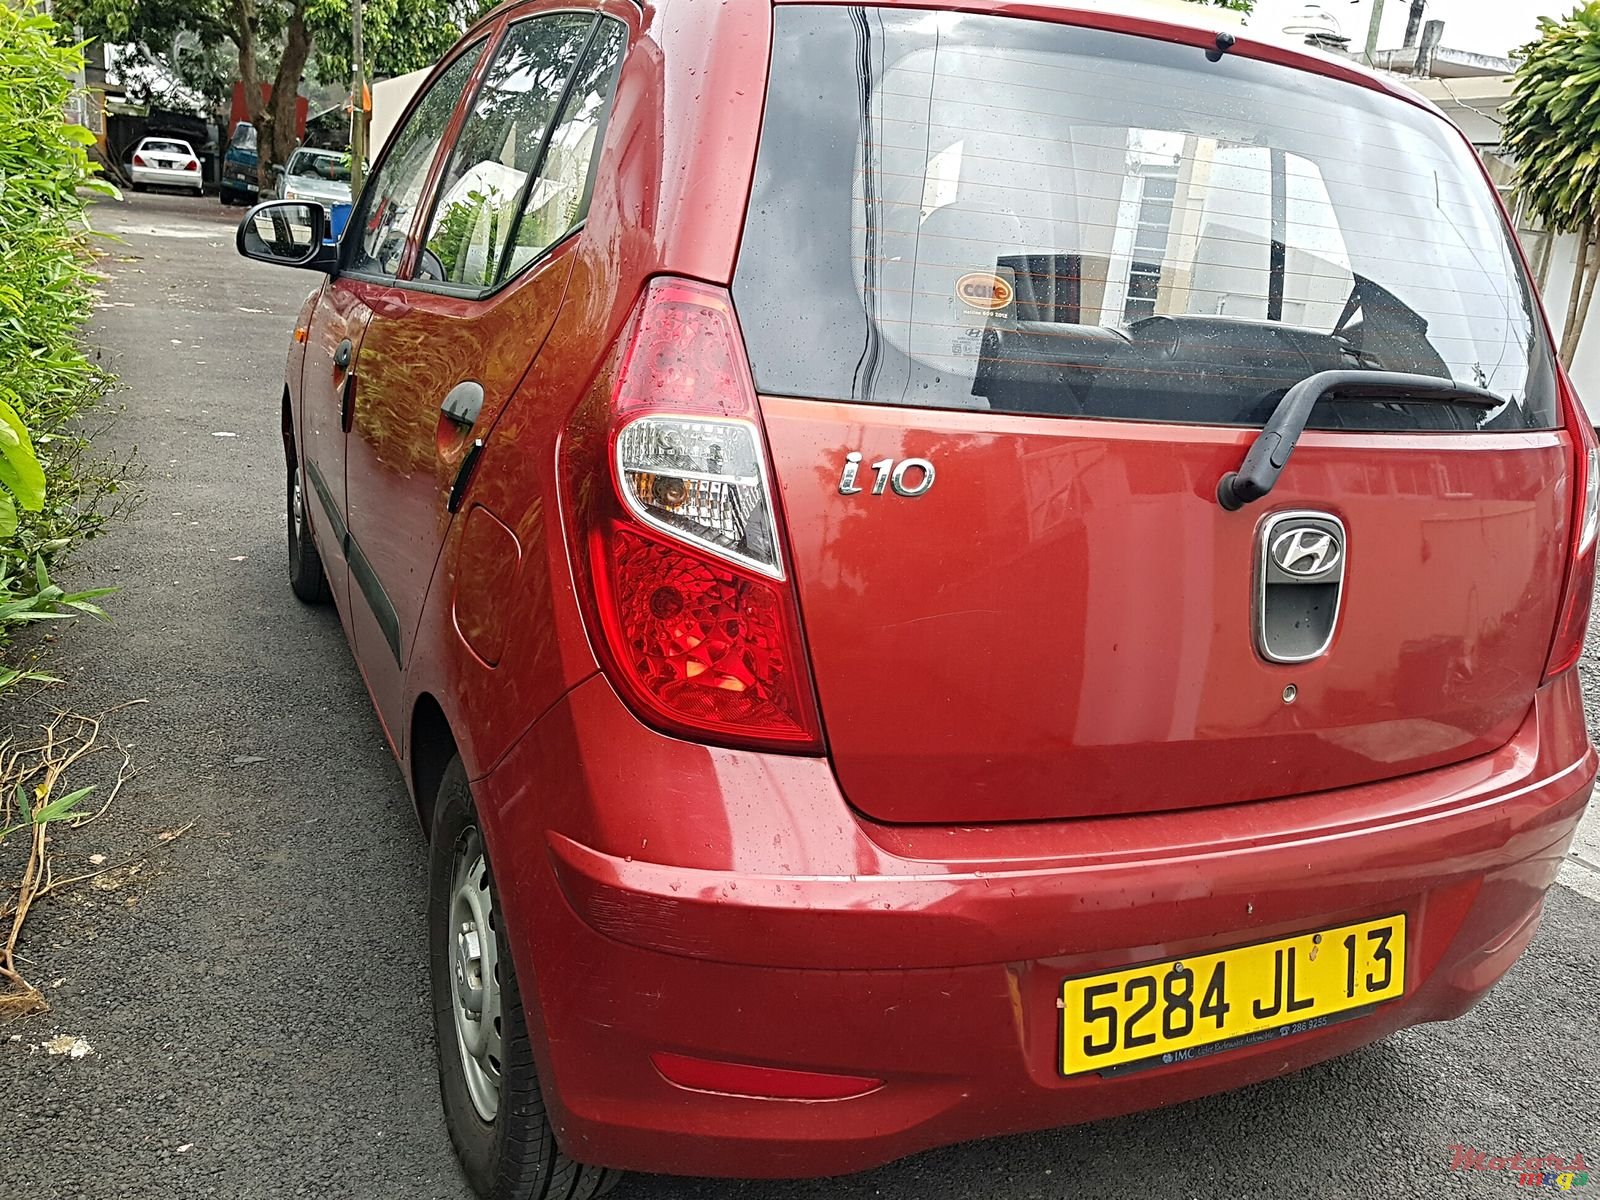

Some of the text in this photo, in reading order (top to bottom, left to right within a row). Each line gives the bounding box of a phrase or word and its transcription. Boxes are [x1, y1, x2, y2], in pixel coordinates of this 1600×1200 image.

[838, 451, 936, 497] i10
[1083, 926, 1393, 1057] 5284 JL 13
[1174, 1049, 1195, 1062] IMC
[1292, 1021, 1307, 1034] 286
[1308, 1017, 1328, 1031] 9255
